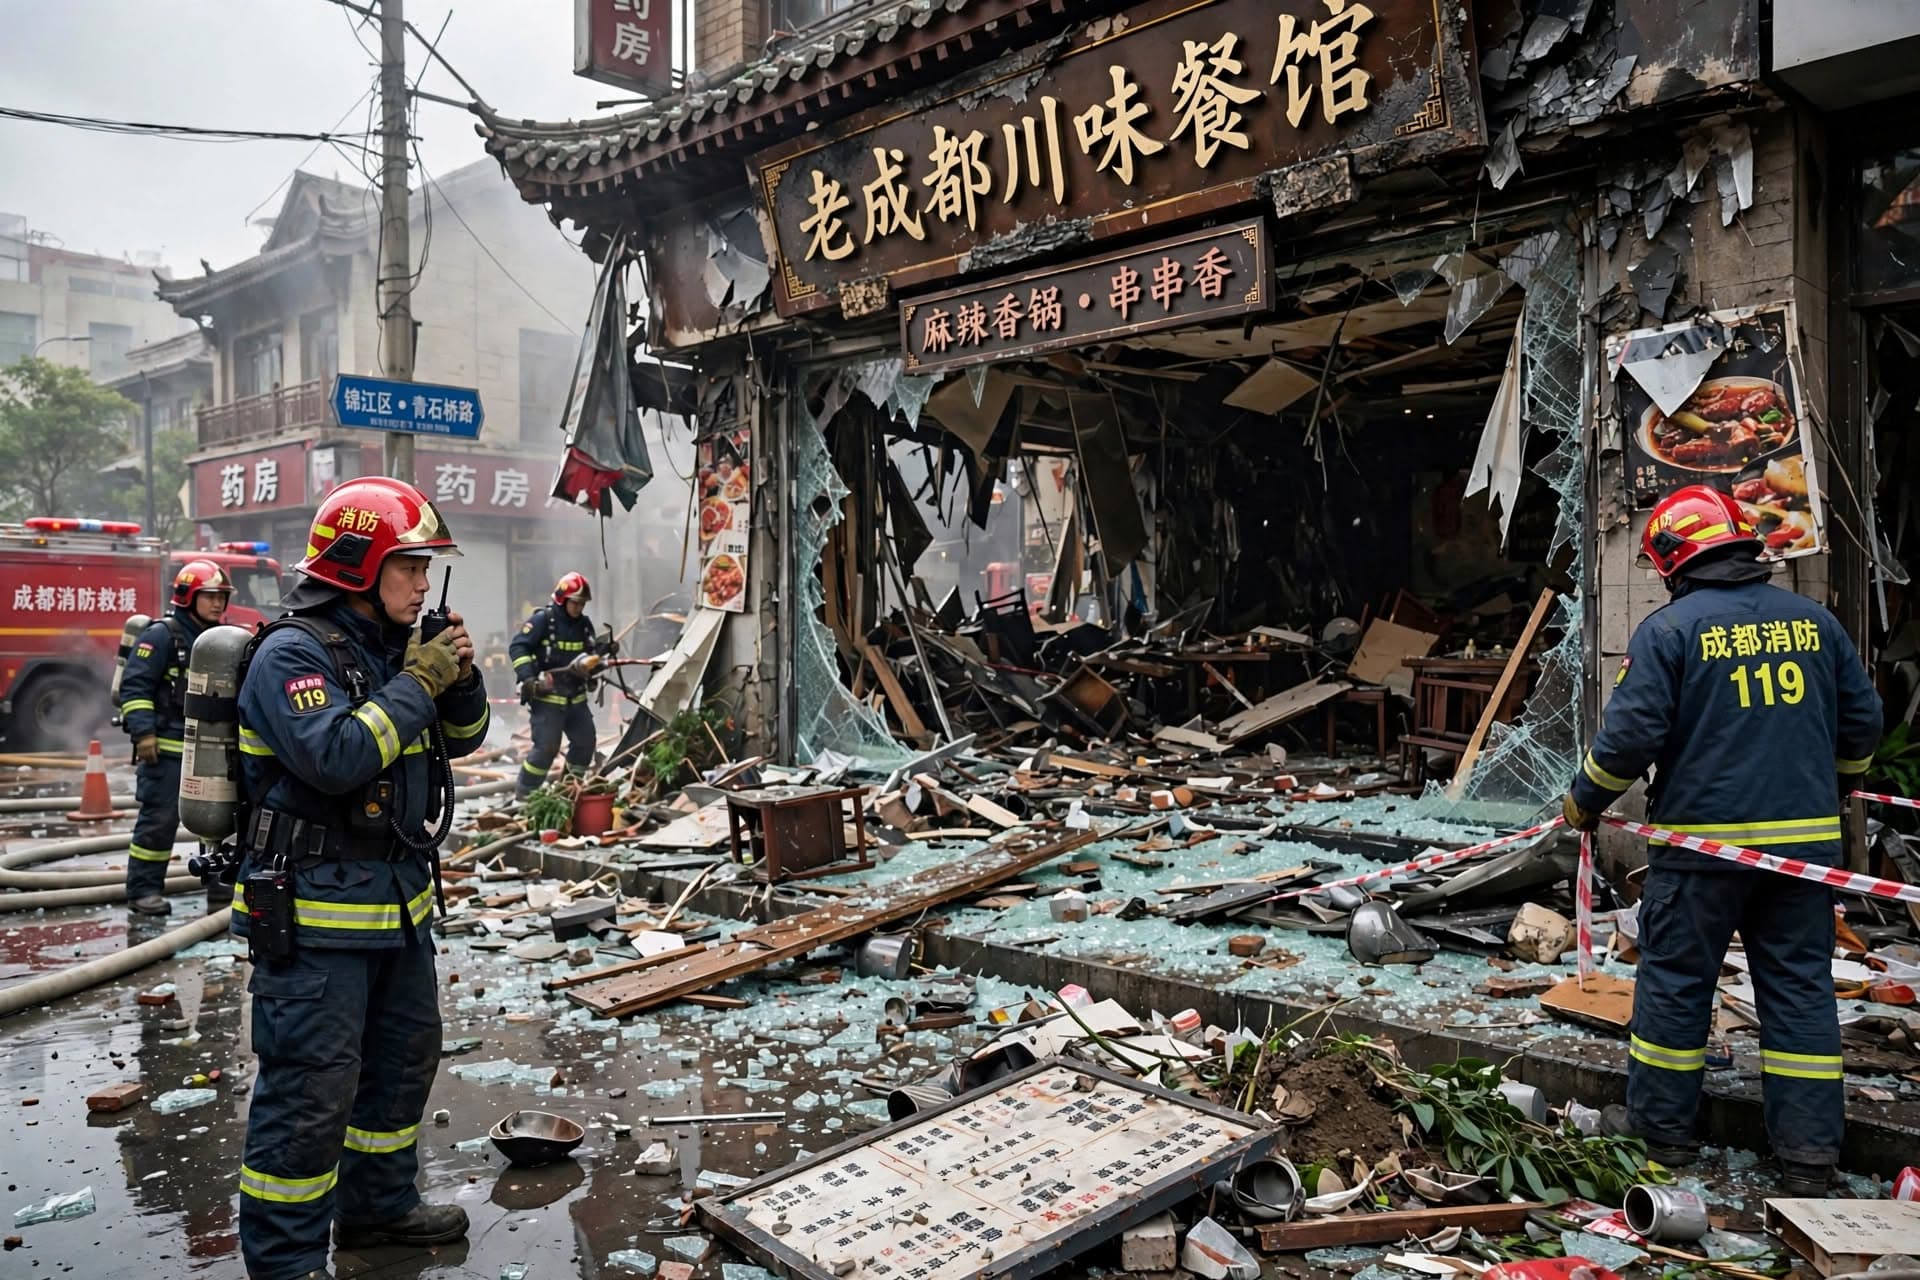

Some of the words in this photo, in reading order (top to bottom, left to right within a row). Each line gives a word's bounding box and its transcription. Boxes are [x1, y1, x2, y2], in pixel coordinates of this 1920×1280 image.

[799, 0, 1376, 262] 老成都川味餐馆
[220, 457, 279, 508] 药房
[336, 506, 382, 533] 消防
[12, 583, 137, 613] 成都消防救援
[1700, 619, 1821, 662] 成都消防
[293, 689, 326, 710] 119
[1729, 660, 1805, 708] 119
